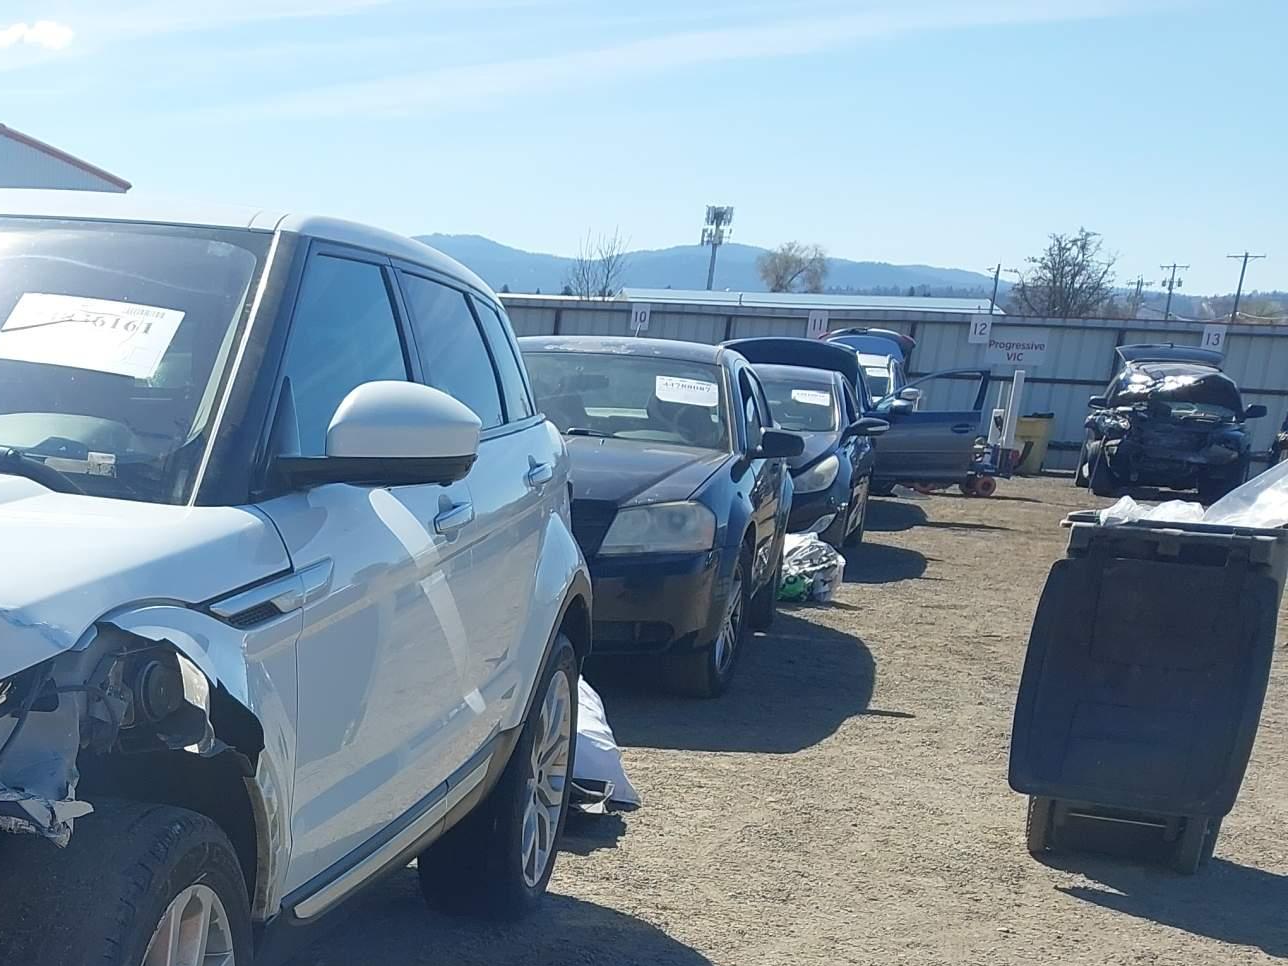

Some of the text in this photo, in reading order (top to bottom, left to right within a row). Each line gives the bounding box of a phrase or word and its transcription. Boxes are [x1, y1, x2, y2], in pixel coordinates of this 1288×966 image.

[633, 310, 647, 323] 10
[812, 318, 823, 332] 11
[973, 322, 988, 336] 12
[1206, 333, 1220, 345] 13
[988, 340, 1046, 351] Progressive
[1006, 352, 1024, 361] VIC
